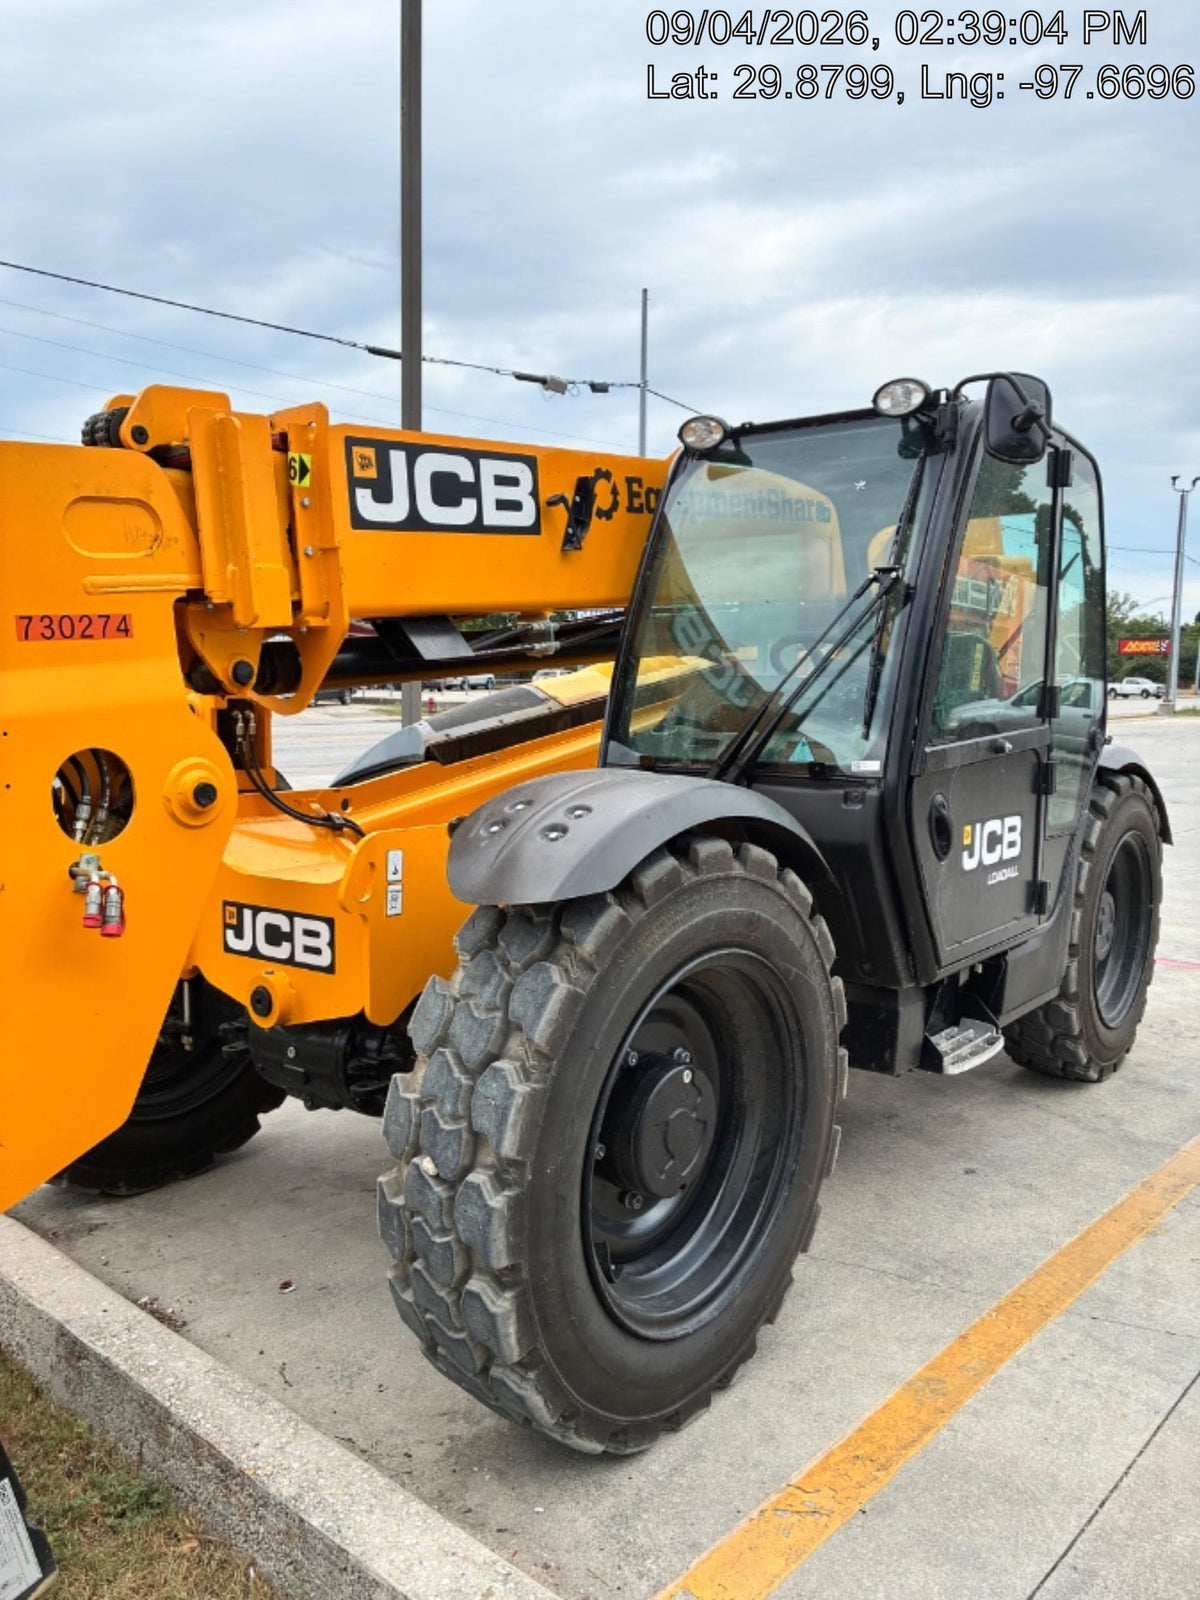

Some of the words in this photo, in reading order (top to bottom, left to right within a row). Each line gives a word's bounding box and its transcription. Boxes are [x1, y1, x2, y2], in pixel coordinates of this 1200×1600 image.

[289, 456, 298, 481] 6
[354, 449, 536, 527] JCB
[18, 614, 130, 640] 730274
[962, 815, 1022, 871] JCB
[225, 908, 332, 967] JCB
